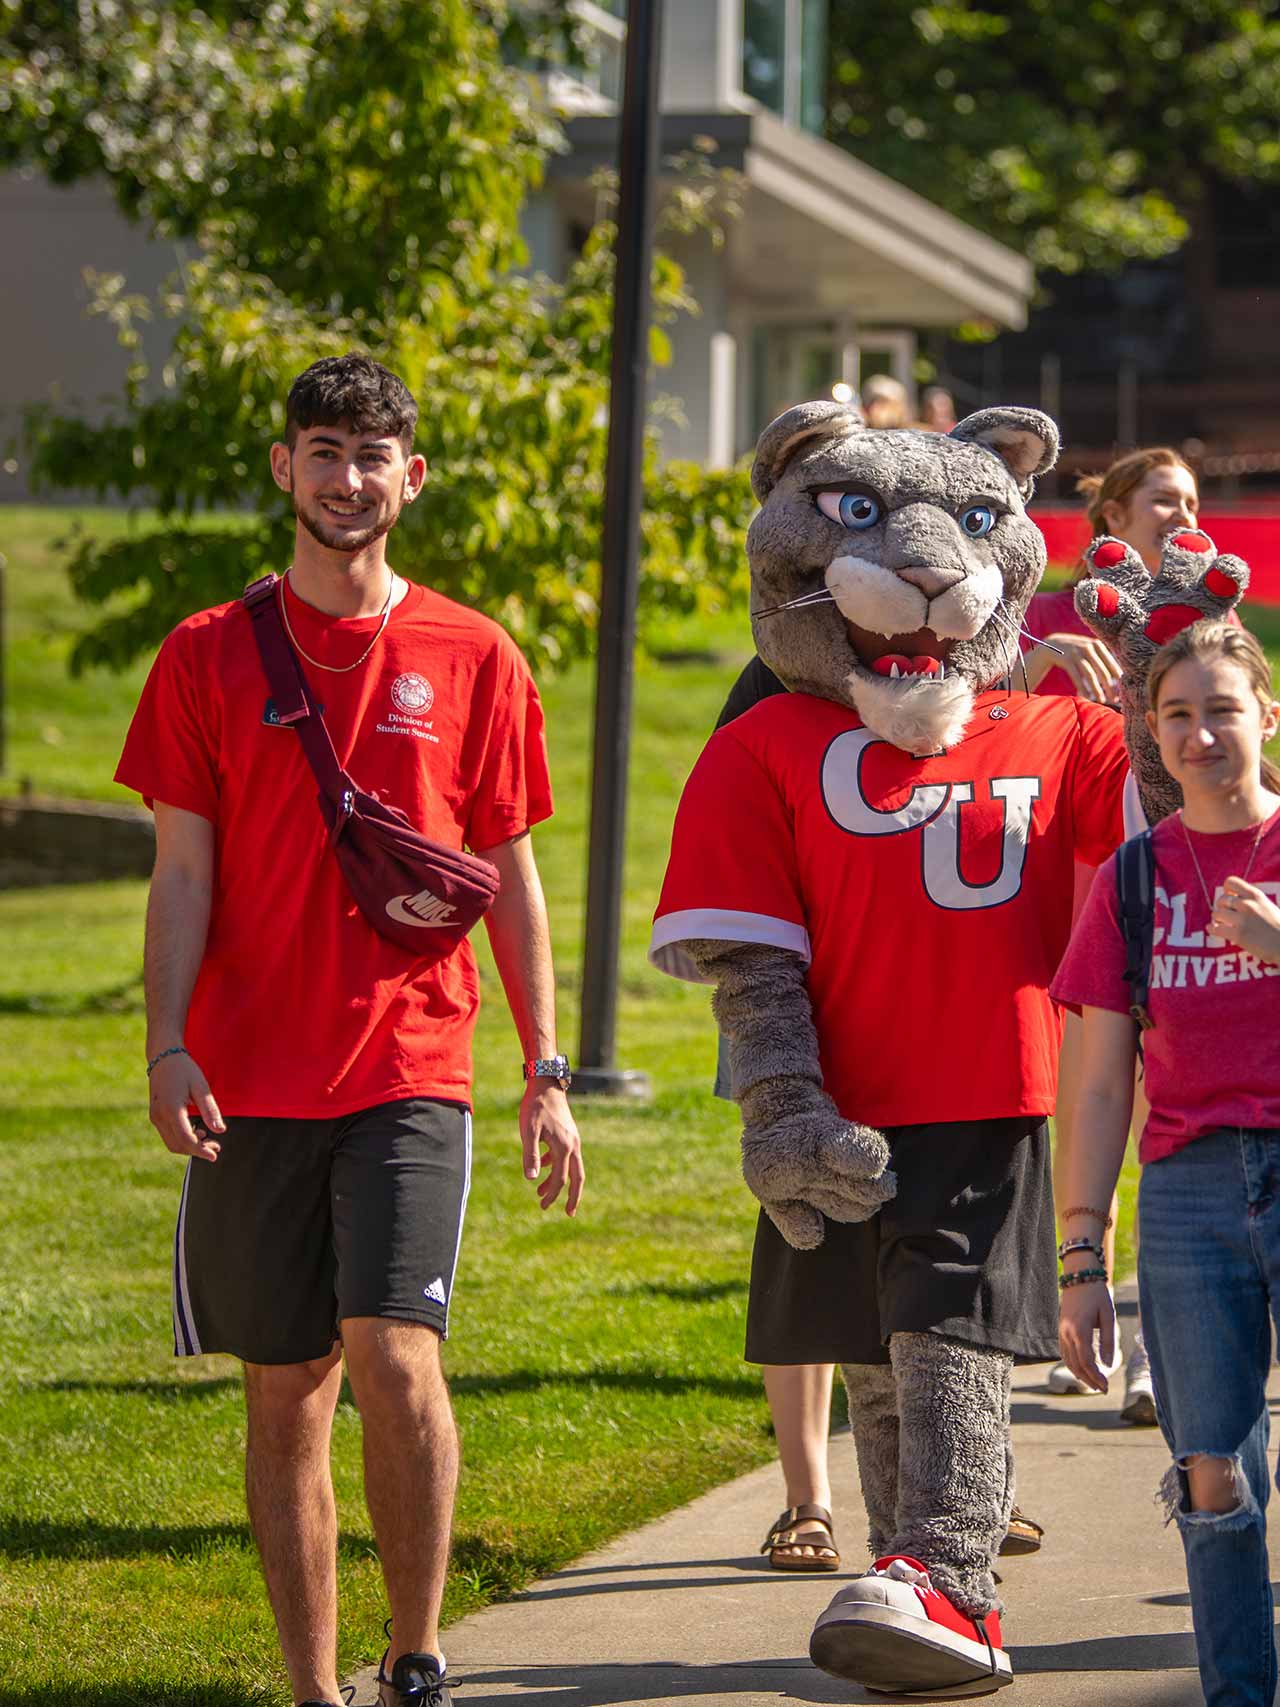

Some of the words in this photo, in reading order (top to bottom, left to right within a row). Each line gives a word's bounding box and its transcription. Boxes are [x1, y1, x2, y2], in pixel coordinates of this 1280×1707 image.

[376, 723, 410, 736] Student
[411, 727, 440, 744] Success
[388, 713, 423, 728] Division
[424, 721, 434, 730] of
[819, 725, 1043, 912] CU
[405, 888, 458, 922] NIKE
